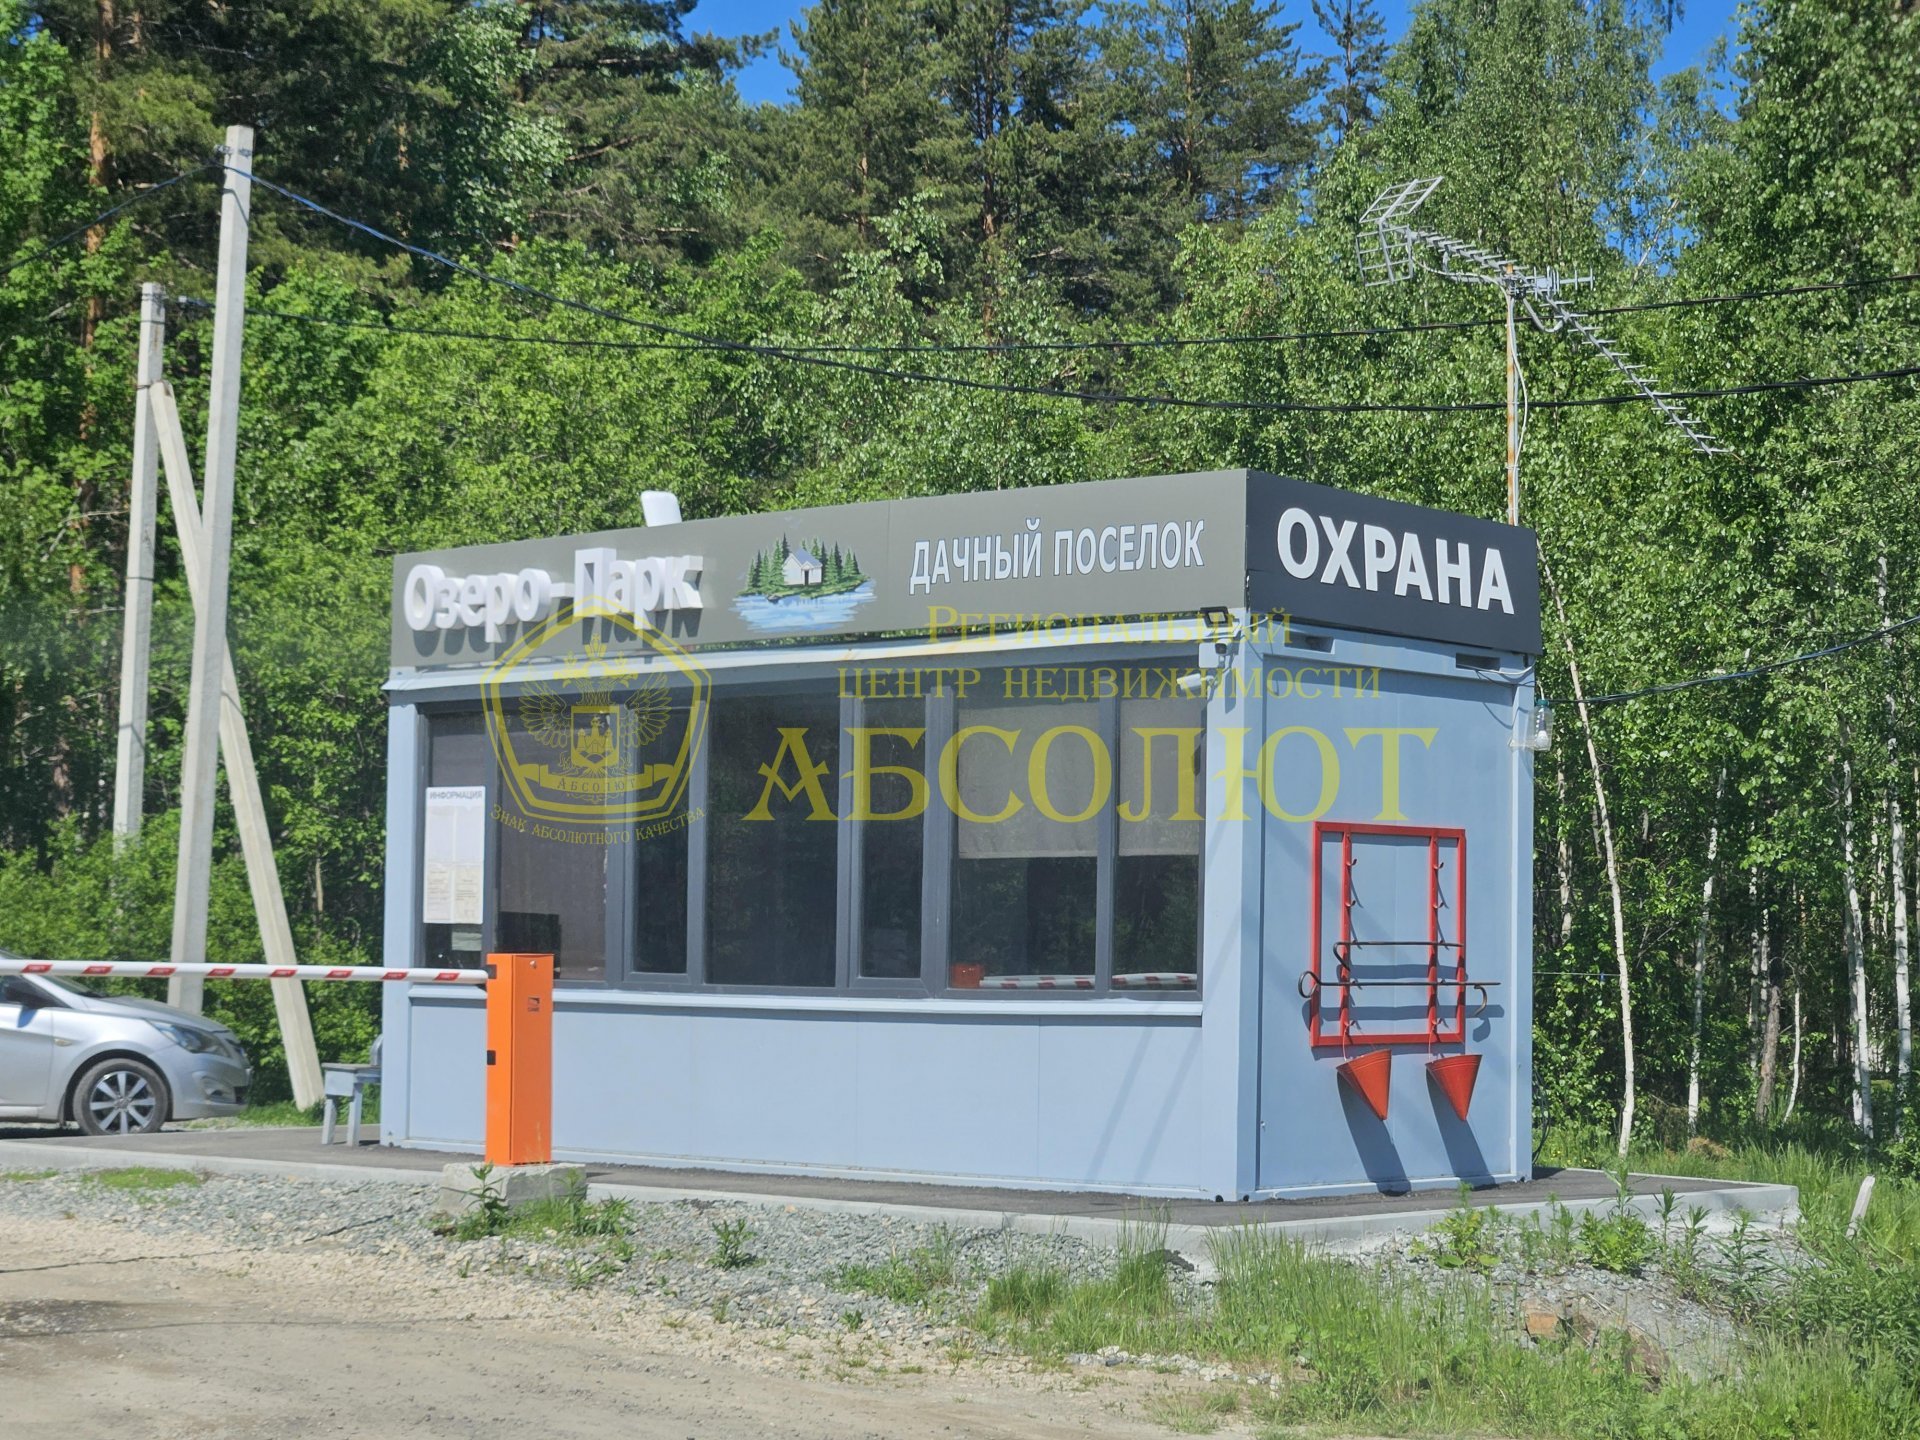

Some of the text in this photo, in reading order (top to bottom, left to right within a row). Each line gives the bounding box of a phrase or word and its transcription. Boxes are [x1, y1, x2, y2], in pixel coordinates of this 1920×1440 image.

[404, 547, 703, 643] Озеро-Парк
[909, 518, 1205, 595] ДАЧНЫЙ ПОСЕЛОК
[1277, 508, 1514, 615] ОХРАНА
[429, 791, 483, 800] ИНФОРМАЦИЯ
